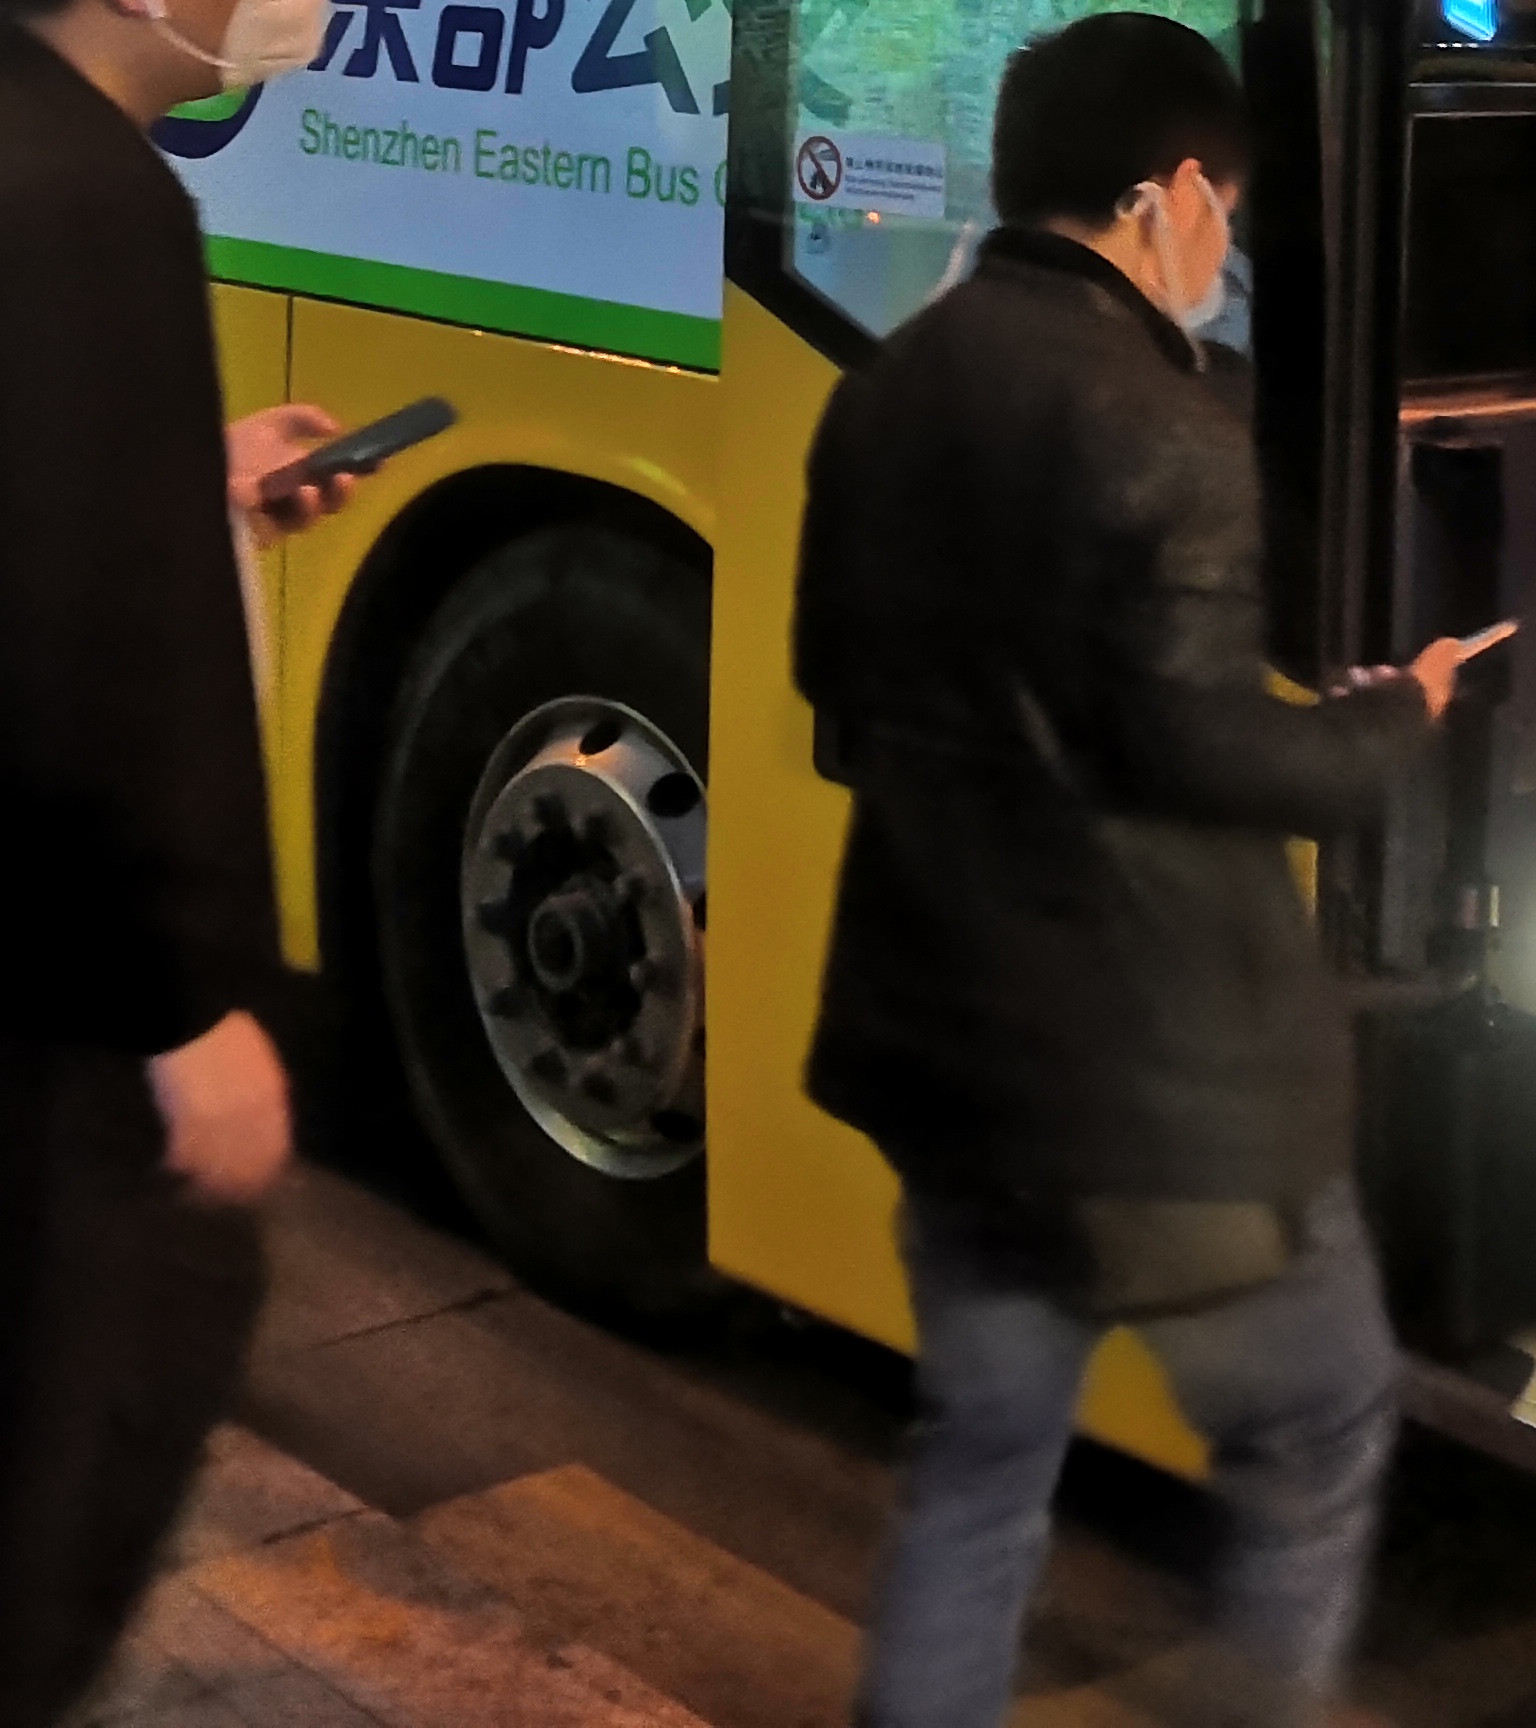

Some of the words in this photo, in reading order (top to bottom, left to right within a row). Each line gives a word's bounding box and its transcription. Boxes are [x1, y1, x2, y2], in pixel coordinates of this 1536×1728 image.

[298, 107, 462, 173] Shenzhen
[473, 129, 613, 196] Eastern
[624, 147, 701, 207] Bus
